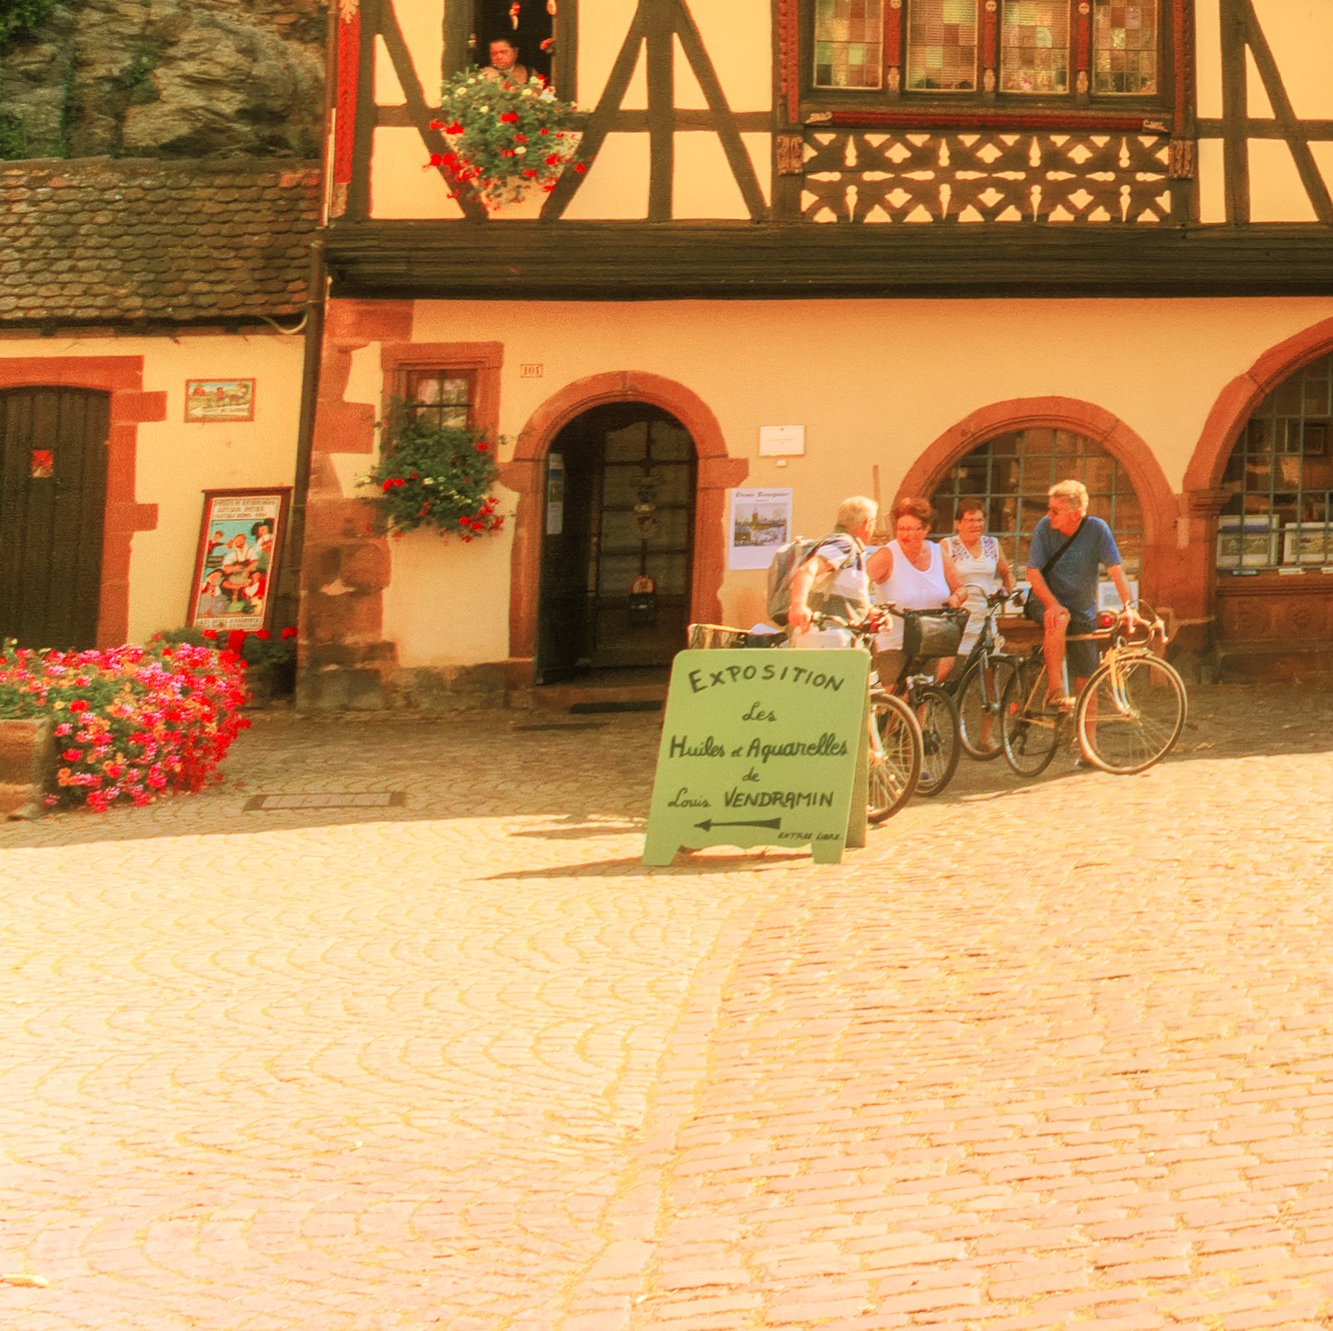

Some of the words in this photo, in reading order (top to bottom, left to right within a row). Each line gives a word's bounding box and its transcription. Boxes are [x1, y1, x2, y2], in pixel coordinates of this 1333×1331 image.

[688, 664, 845, 694] EXPOSITION
[741, 700, 778, 722] Les
[668, 735, 725, 759] Huiles
[730, 745, 743, 758] et
[746, 732, 848, 763] Aquarelles
[741, 766, 761, 783] de
[667, 787, 712, 808] Louis
[724, 786, 834, 810] VENDRAMIN
